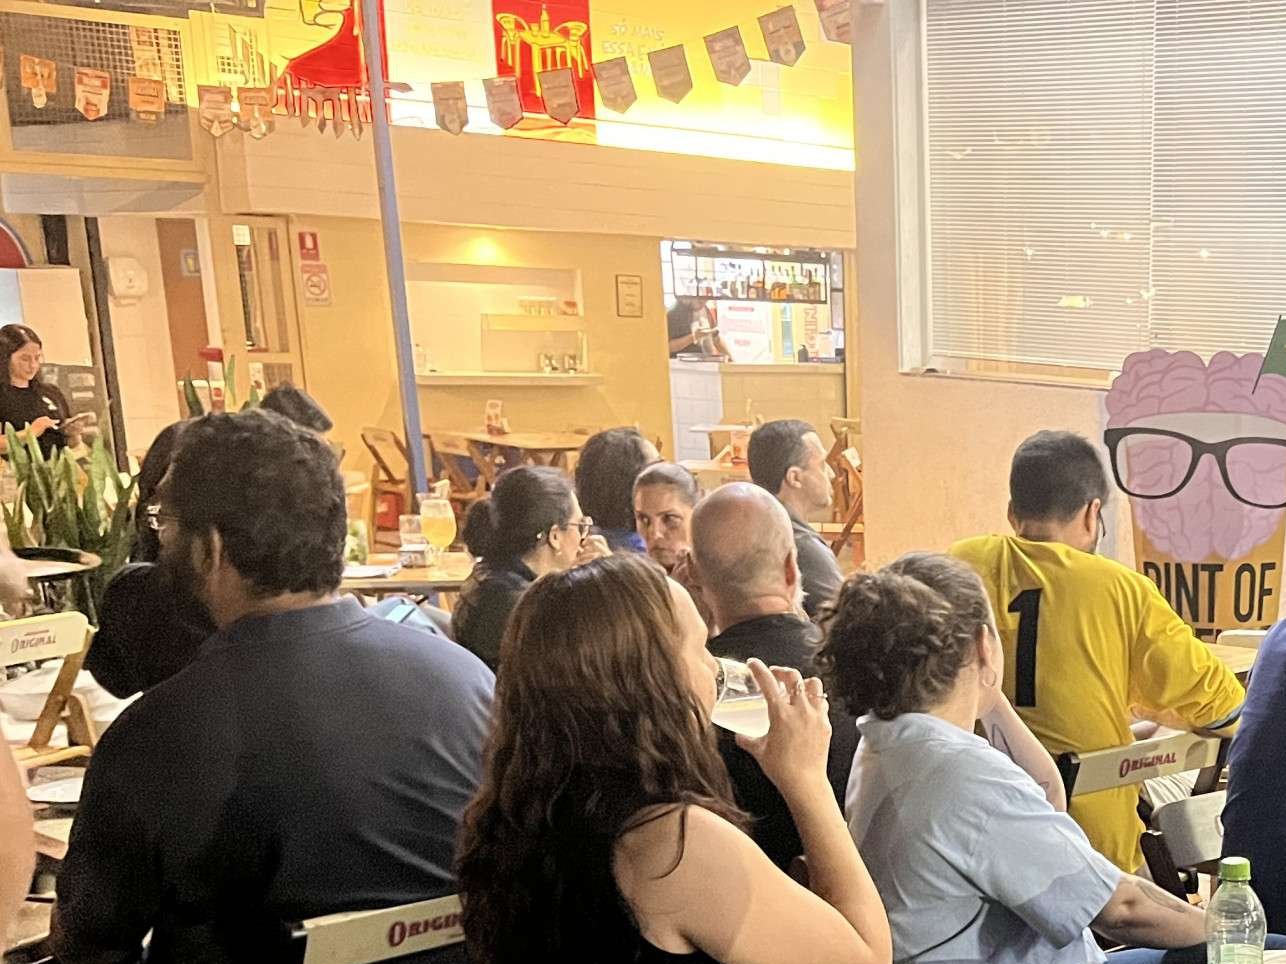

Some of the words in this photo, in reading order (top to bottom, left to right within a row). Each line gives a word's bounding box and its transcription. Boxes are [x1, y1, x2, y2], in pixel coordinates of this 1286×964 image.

[1233, 562, 1276, 623] OF
[10, 635, 56, 654] ORIGINAL
[1008, 588, 1042, 707] 1
[1119, 752, 1177, 778] ORIGINAL
